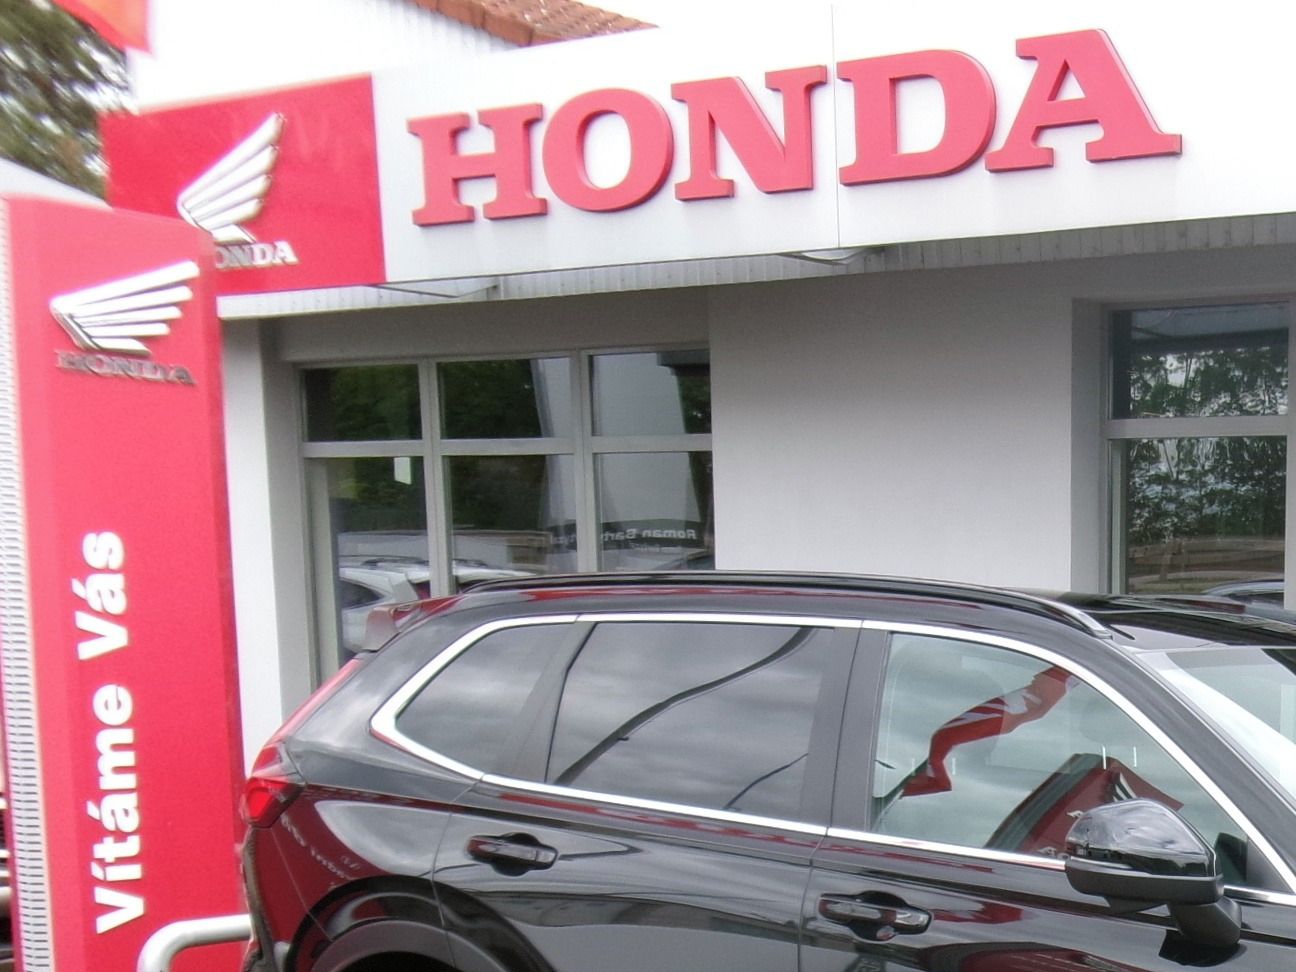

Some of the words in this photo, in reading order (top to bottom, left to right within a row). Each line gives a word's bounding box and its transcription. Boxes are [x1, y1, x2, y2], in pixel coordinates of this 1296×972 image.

[407, 28, 1182, 226] HONDA
[215, 240, 298, 269] ONDA
[54, 350, 196, 386] HONDA
[72, 531, 128, 660] Vás
[87, 684, 147, 934] Vítáme
